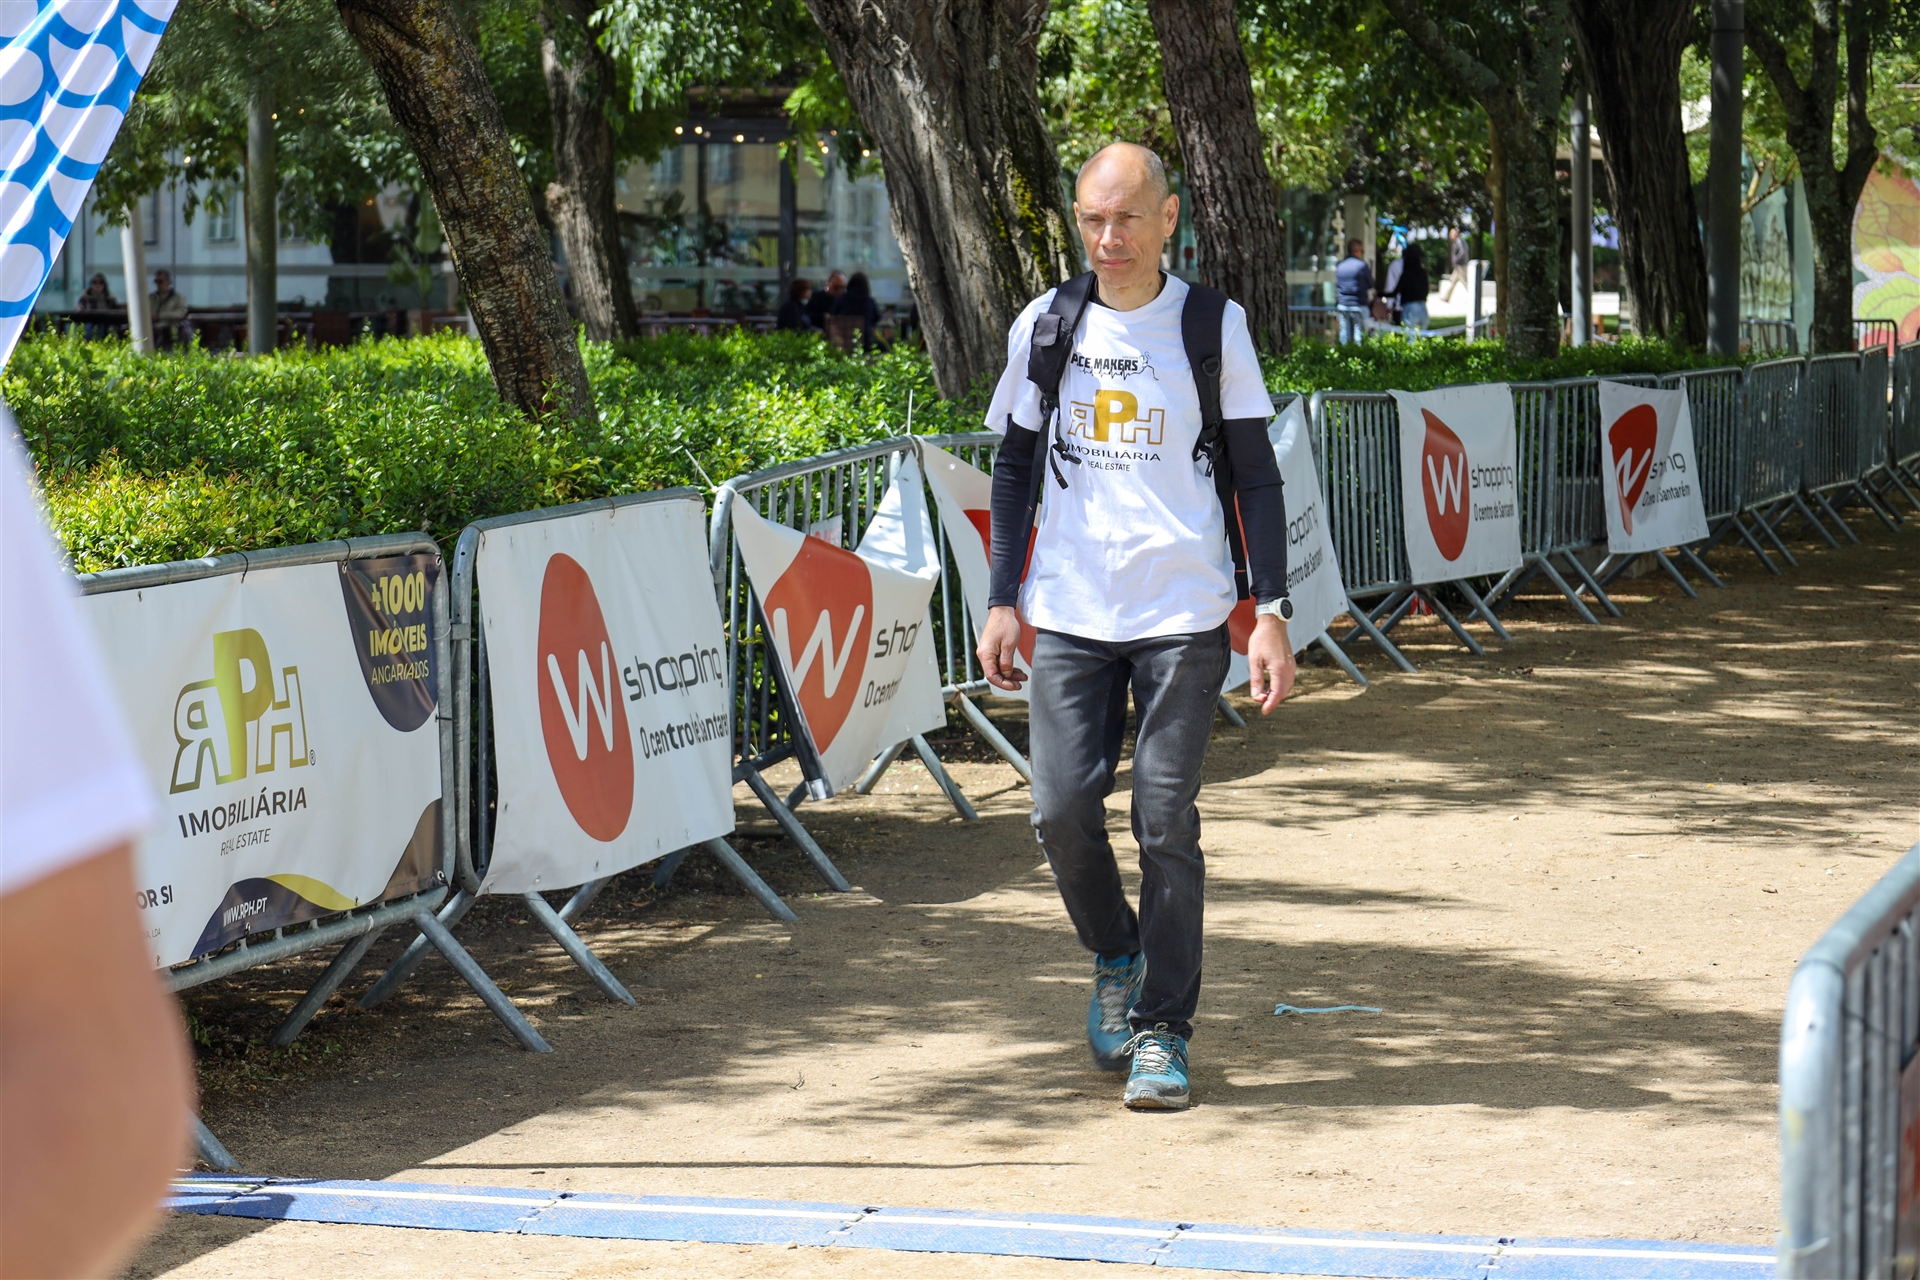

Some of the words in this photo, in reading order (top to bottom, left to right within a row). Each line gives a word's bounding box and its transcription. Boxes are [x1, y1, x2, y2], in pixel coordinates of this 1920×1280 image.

[1070, 353, 1091, 369] ACE
[1094, 358, 1138, 371] MAKERS
[1105, 462, 1131, 472] ESTATE
[1427, 452, 1464, 516] W
[1471, 462, 1514, 491] shopping
[372, 571, 425, 615] +1000
[369, 620, 428, 657] IMÓVEIS
[371, 659, 429, 686] ANGARIADOS
[547, 640, 614, 761] W
[650, 722, 695, 757] centro
[178, 786, 307, 838] IMOBILIÁRIA
[220, 838, 235, 857] REAL
[235, 828, 271, 849] ESTATE
[160, 884, 173, 905] SI
